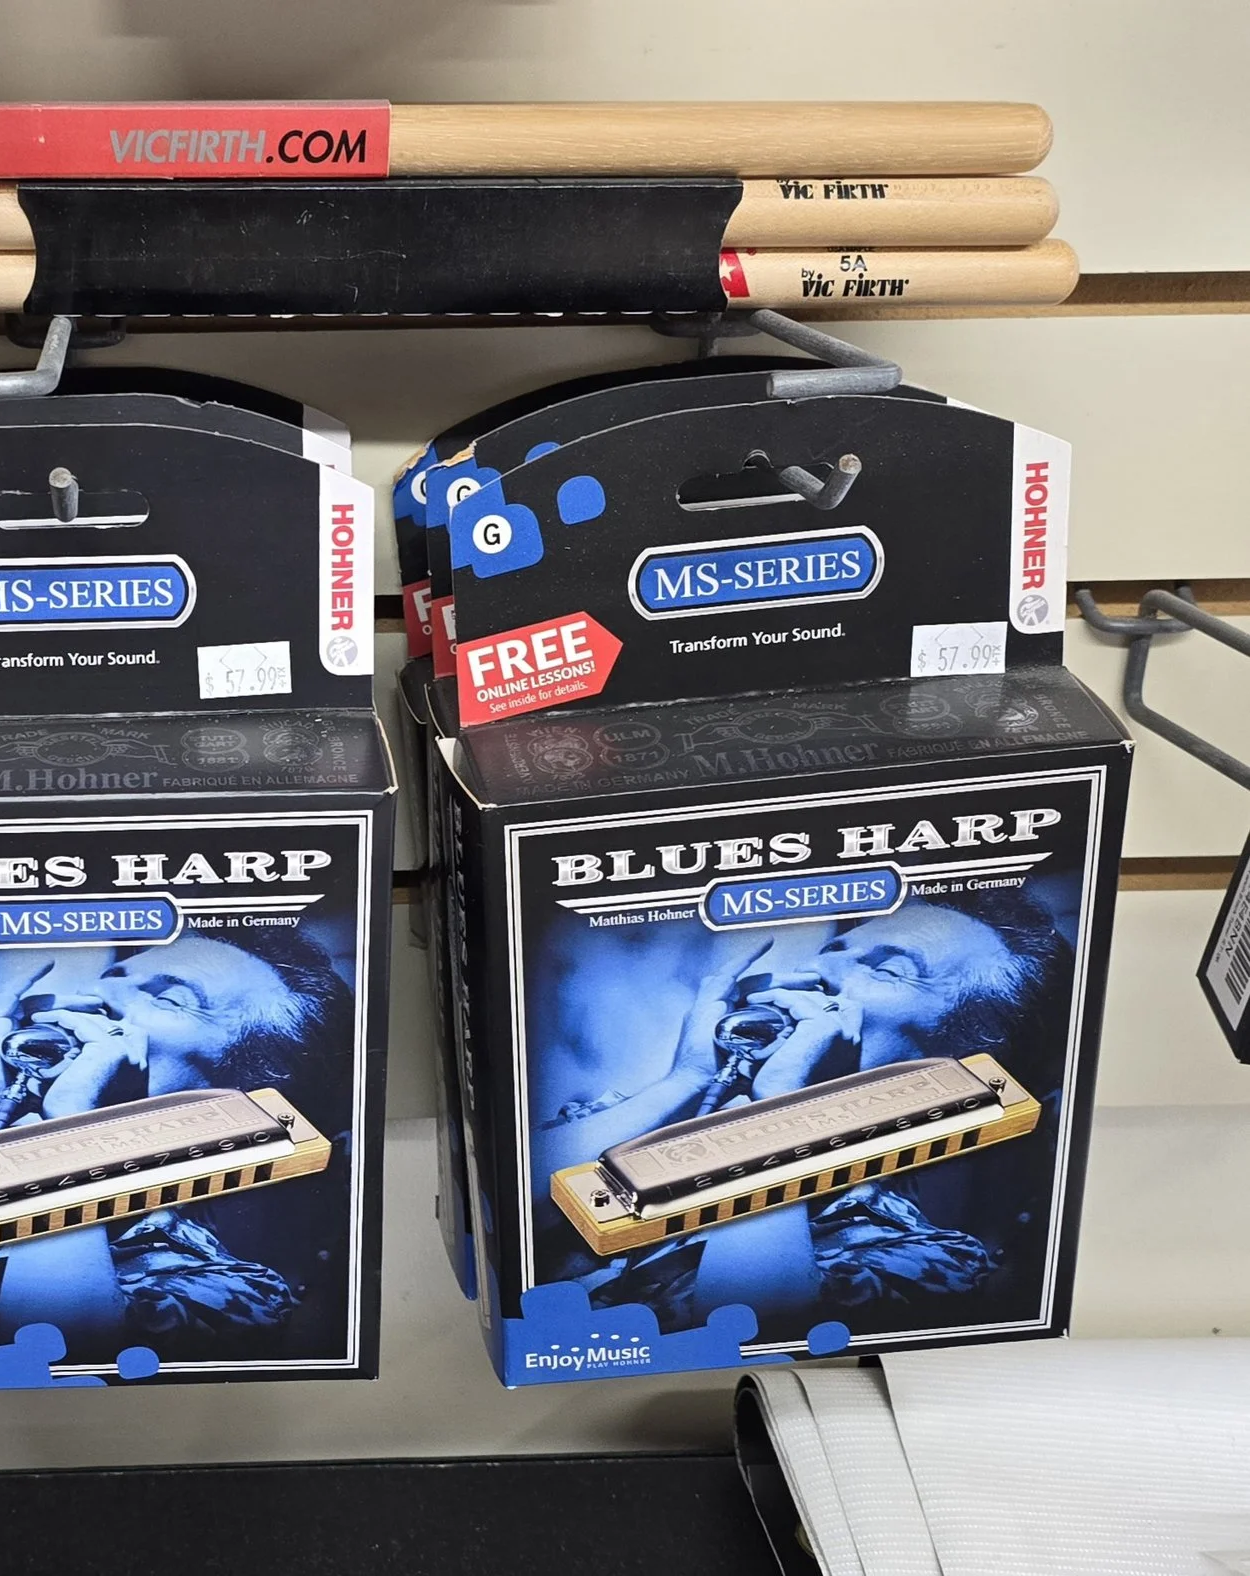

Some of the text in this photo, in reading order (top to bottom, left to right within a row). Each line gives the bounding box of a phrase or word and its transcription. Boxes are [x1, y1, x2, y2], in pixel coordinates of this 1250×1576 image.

[110, 129, 367, 163] VICFIRTH.COM
[780, 181, 814, 199] VIC
[840, 255, 868, 272] 5A
[802, 274, 835, 297] VIC
[483, 523, 501, 546] G
[1022, 461, 1049, 591] HOHNER
[331, 503, 354, 631] HOHNER
[653, 549, 862, 601] MS-SERIES
[669, 623, 846, 654] Transform Your Sound.
[67, 651, 105, 666] Your
[107, 649, 160, 666] Sound.
[466, 620, 593, 688] FREE
[937, 644, 992, 671] 57.99
[225, 667, 277, 692] 57.99
[476, 660, 596, 703] ONLINE LESSONS!
[489, 699, 506, 714] See
[508, 692, 536, 709] inside
[538, 688, 552, 701] for
[99, 727, 153, 740] MARK
[242, 775, 262, 786] EN
[265, 773, 358, 786] ALLEMAGNE
[598, 767, 690, 788] GERMANY
[551, 807, 1063, 887] BLUES HARP
[111, 849, 333, 887] HARP
[721, 879, 888, 917] MS-SERIES
[911, 874, 1026, 897] Made in Germany
[0, 908, 164, 937] MS-SERIES
[187, 913, 300, 930] Made in Germany
[589, 906, 696, 928] Matthias Hohner
[727, 1165, 746, 1178] 3
[794, 1145, 813, 1158] 5
[829, 1136, 847, 1149] 6
[861, 1127, 878, 1140] 7
[926, 1107, 945, 1120] 9
[23, 1183, 42, 1195] 3
[88, 1167, 108, 1181] 5
[122, 1160, 141, 1173] 6
[154, 1153, 171, 1166] 7
[218, 1139, 236, 1151] 9
[586, 1361, 611, 1369] PLAY
